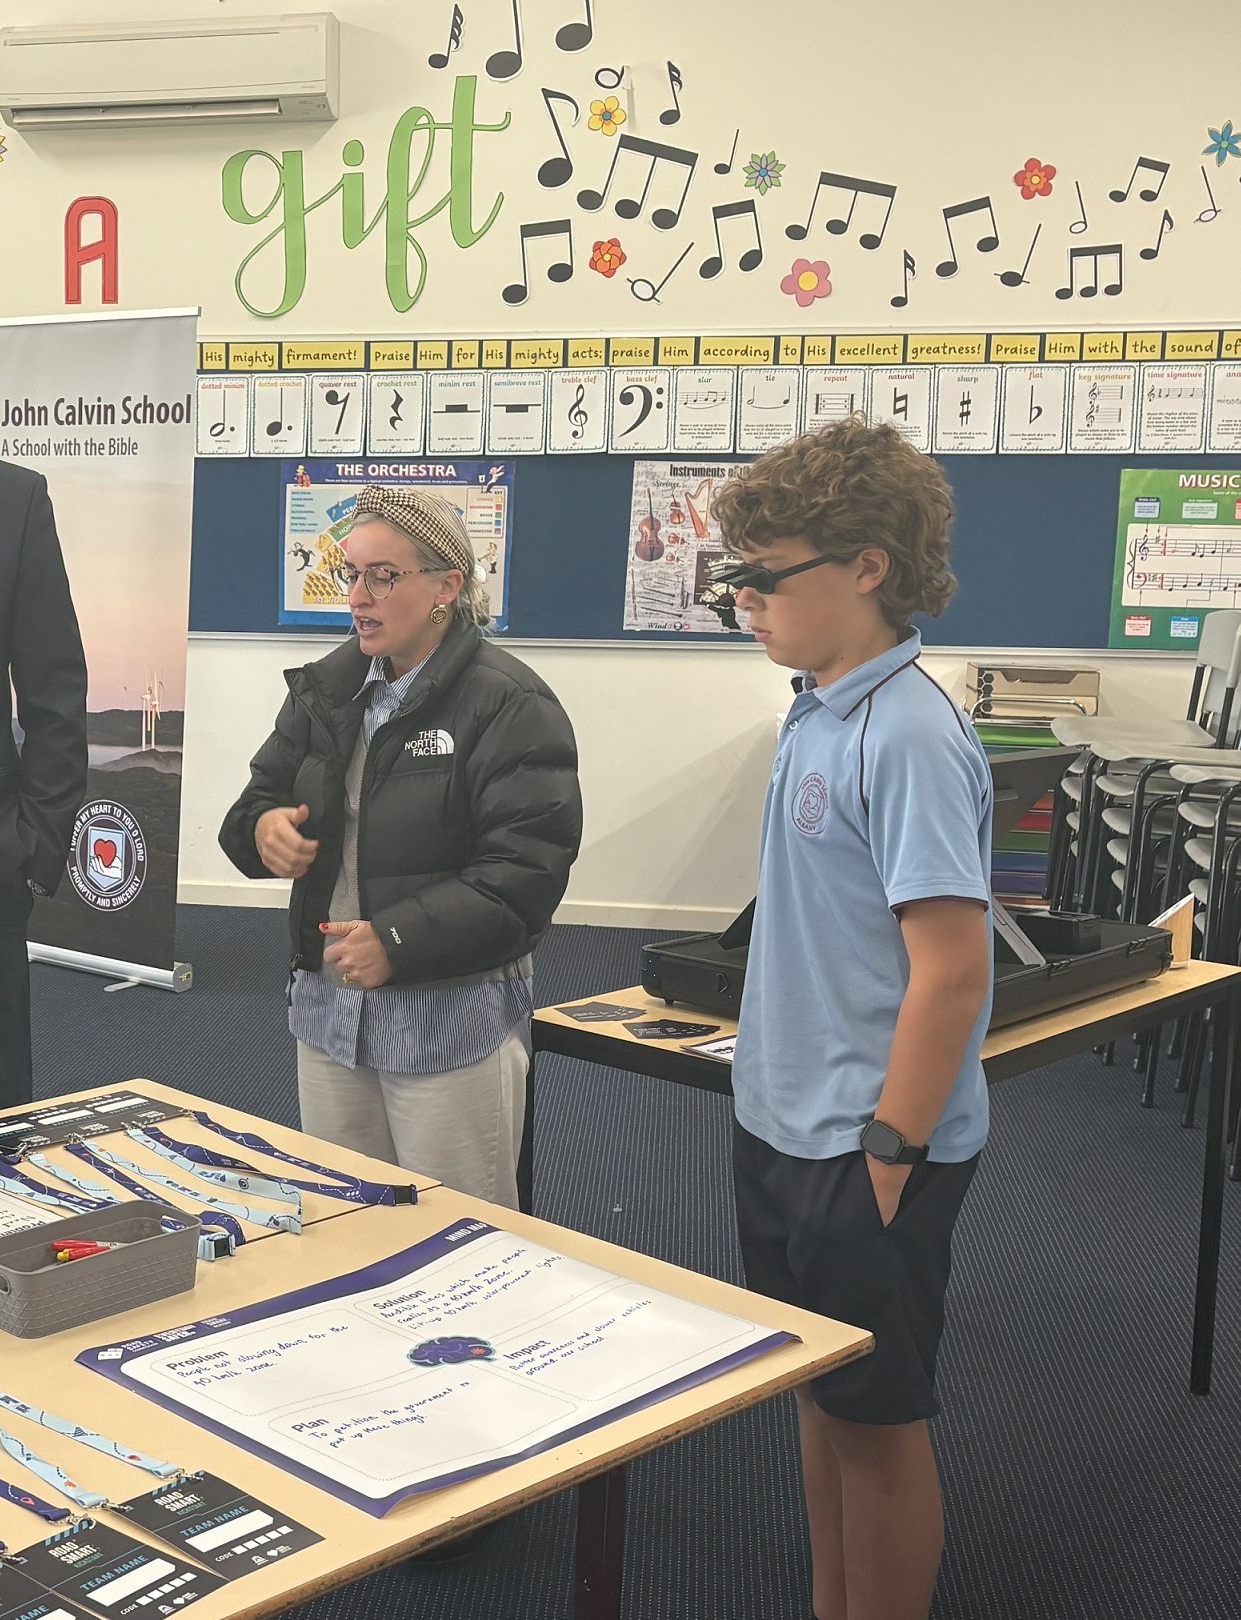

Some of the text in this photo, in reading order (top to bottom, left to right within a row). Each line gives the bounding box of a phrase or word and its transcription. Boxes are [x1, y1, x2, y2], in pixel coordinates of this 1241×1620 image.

[64, 196, 119, 304] A
[222, 75, 511, 317] gift
[205, 338, 1241, 367] His mighty firmament! Praise Him for His mighty acts; praise Him according to His excellent greatness! Praise Him with the sound of
[561, 375, 597, 384] treble clef
[645, 375, 658, 383] clef
[824, 375, 847, 383] repeat
[1028, 371, 1043, 380] flat
[1078, 373, 1131, 382] key signature
[1166, 371, 1202, 379] signature
[2, 394, 191, 427] John Calvin School
[1, 437, 138, 456] A School with the Bible
[336, 464, 457, 477] THE ORCHESTRA
[669, 463, 726, 478] Instruments
[1179, 474, 1241, 488] MUSIC
[419, 729, 437, 739] THE
[404, 738, 437, 751] NORTH
[412, 747, 437, 758] FACE
[80, 809, 90, 823] MY
[90, 804, 112, 816] HEART
[113, 806, 121, 817] TO
[122, 812, 135, 830] YOU
[132, 829, 137, 837] O
[135, 838, 144, 861] LORD
[71, 866, 141, 907] PROMPTLY AND SINCERELY
[389, 926, 401, 945] 700
[445, 1227, 472, 1242] MIND
[420, 1292, 445, 1305] lines
[447, 1278, 470, 1293] which
[474, 1264, 498, 1278] make
[450, 1293, 463, 1303] 40
[462, 1284, 484, 1298] km/h
[372, 1289, 427, 1310] Solution
[444, 1308, 457, 1316] 40
[456, 1300, 478, 1311] km/h
[576, 1331, 590, 1341] and
[176, 1325, 348, 1378] People not slowing down for the
[503, 1338, 551, 1361] Impact
[166, 1351, 229, 1371] Problem
[525, 1357, 558, 1376] around
[193, 1361, 277, 1387] 40 km/h zone.
[308, 1431, 328, 1439] To
[333, 1415, 379, 1435] petition
[380, 1408, 399, 1416] the
[404, 1387, 453, 1413] government
[291, 1417, 330, 1433] Plan
[329, 1437, 346, 1449] put
[362, 1424, 391, 1434] these
[154, 1490, 184, 1506] ROAD
[164, 1493, 201, 1513] SMART
[179, 1505, 249, 1538] TEAM NAME
[48, 1541, 79, 1558] ROAD
[59, 1544, 98, 1565] SMART
[215, 1552, 234, 1563] CODE
[79, 1555, 149, 1592] TEAM NAME
[120, 1603, 139, 1615] CODE
